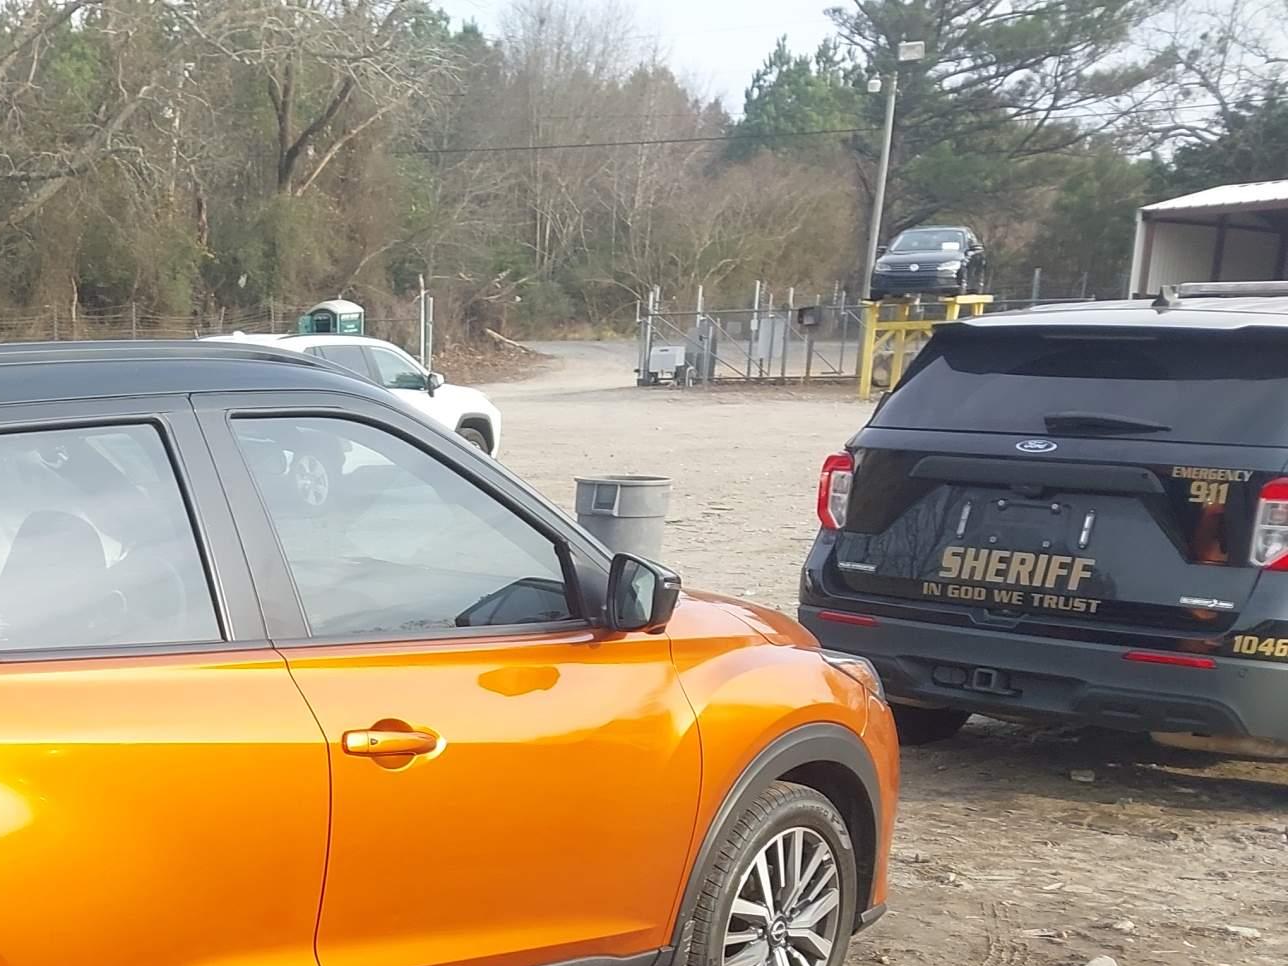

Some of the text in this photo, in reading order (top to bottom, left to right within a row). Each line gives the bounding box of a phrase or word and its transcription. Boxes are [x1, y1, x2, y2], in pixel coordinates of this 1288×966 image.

[1172, 466, 1253, 482] EMERGENCY
[1188, 481, 1229, 505] 911
[939, 546, 1096, 591] SHERIFF
[922, 582, 1101, 613] IN GOD WE TRUST
